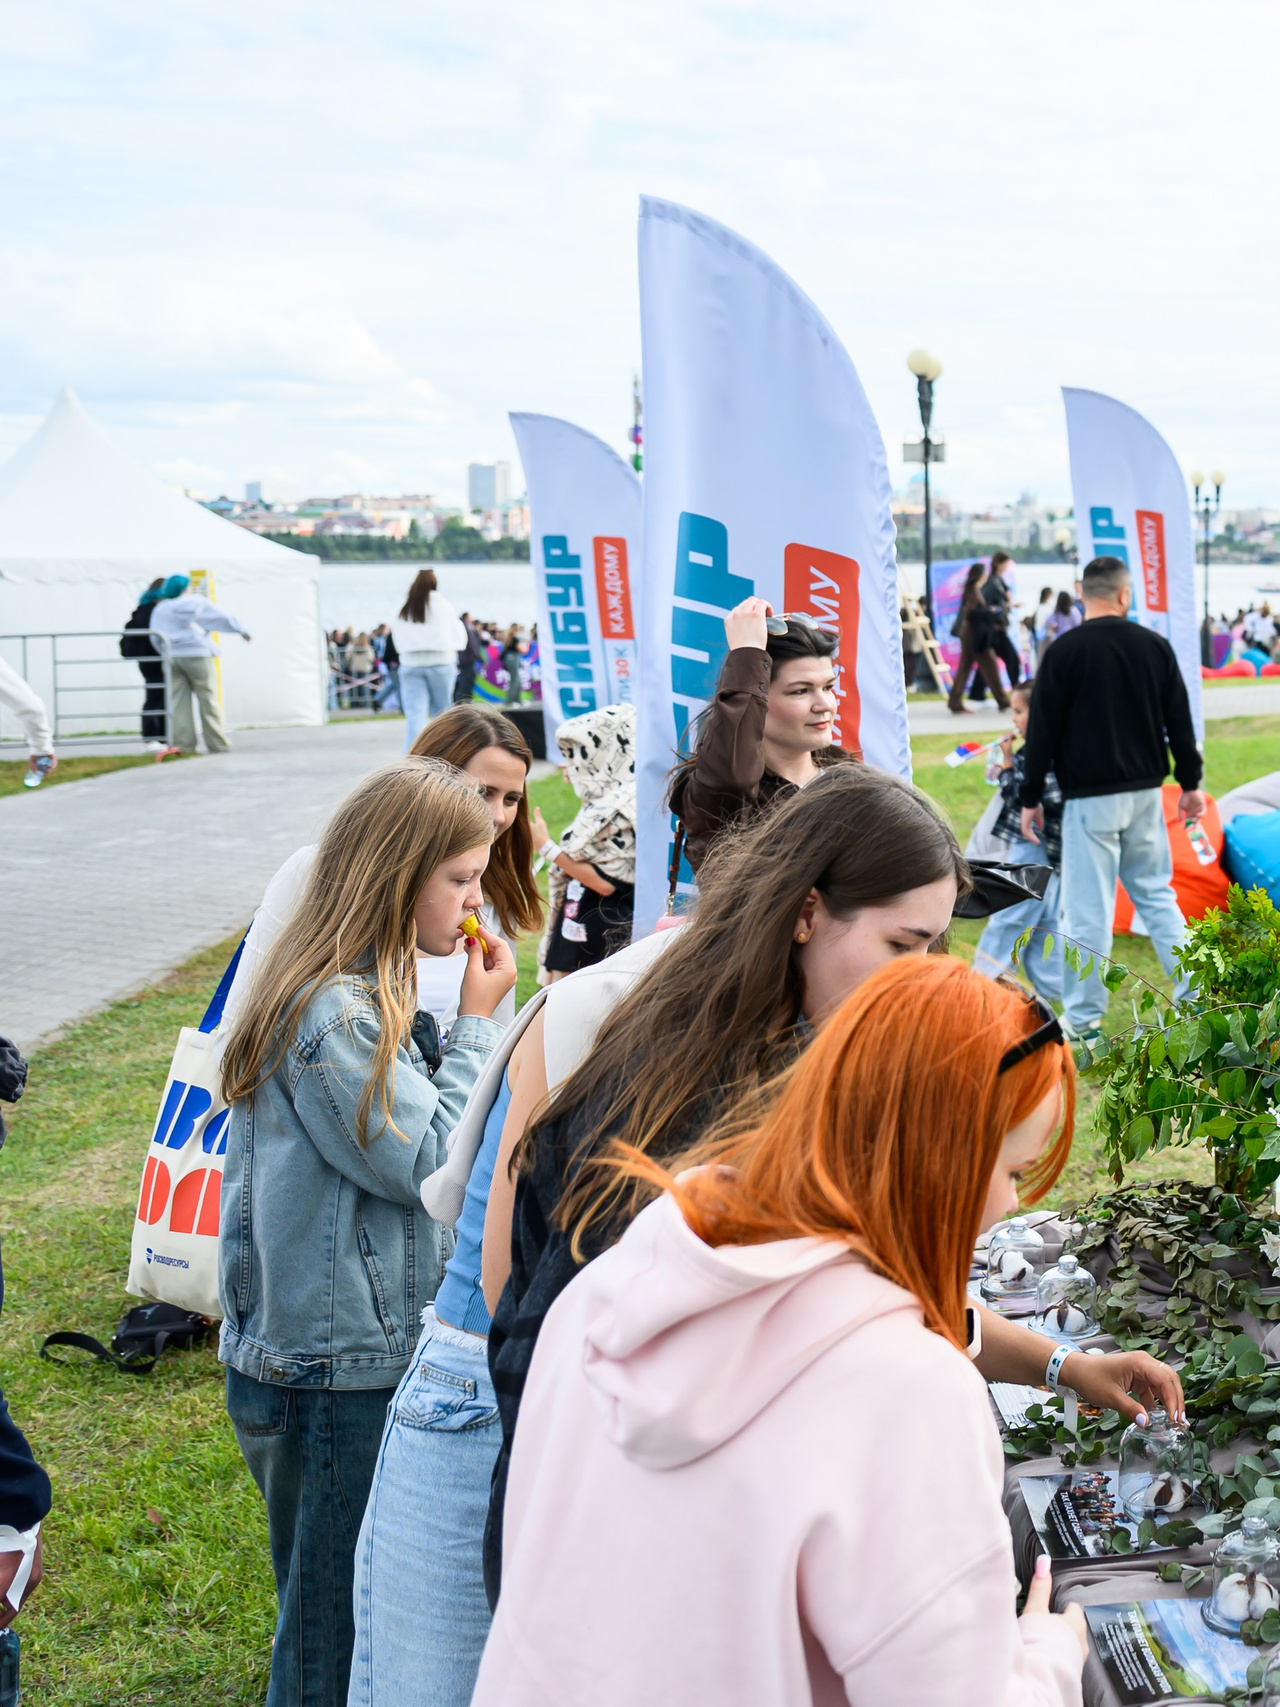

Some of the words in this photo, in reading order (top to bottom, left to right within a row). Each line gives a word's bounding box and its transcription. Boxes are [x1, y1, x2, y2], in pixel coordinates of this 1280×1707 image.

[602, 542, 627, 635] КАЖДОМУ
[1142, 516, 1161, 606] КАЖДОМУ
[542, 534, 598, 720] СИБУР
[613, 647, 631, 703] ЛИЗОК
